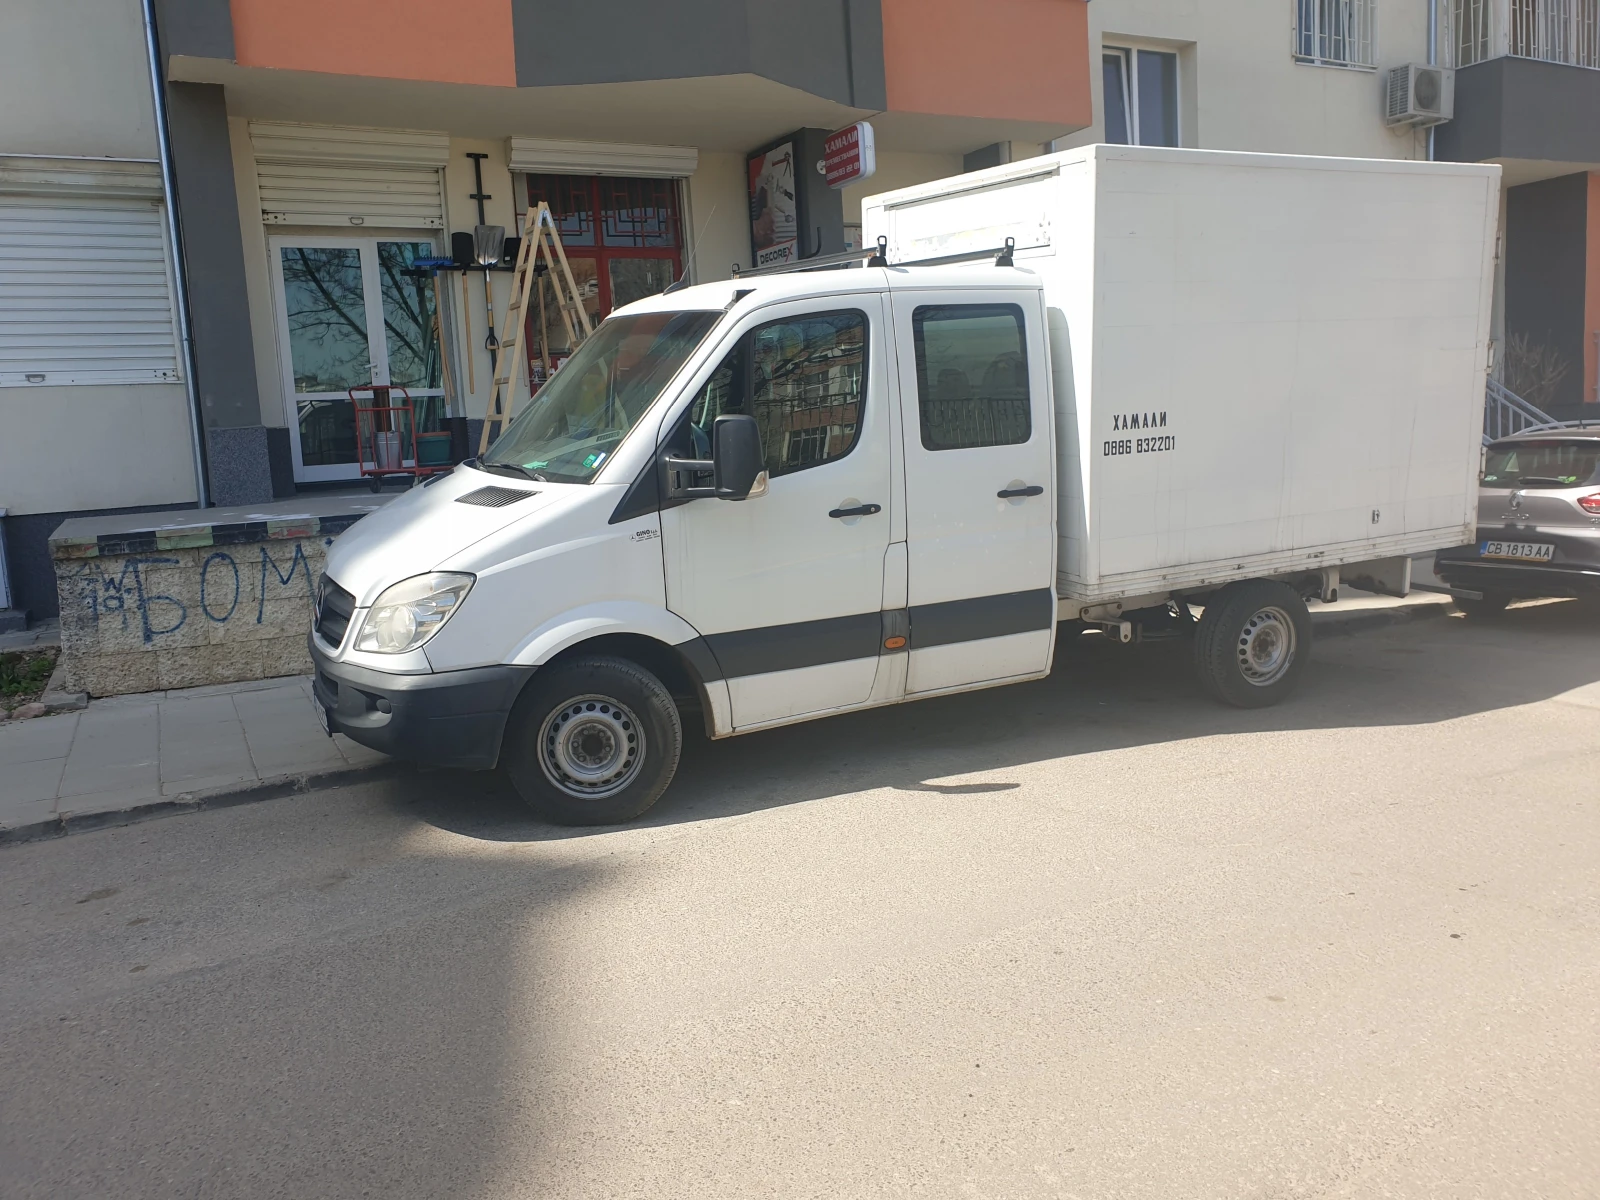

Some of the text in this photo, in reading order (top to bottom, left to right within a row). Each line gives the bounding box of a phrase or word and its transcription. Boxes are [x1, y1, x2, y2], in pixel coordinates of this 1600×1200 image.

[824, 130, 858, 154] ХАМАЛИ
[760, 243, 793, 264] DECOREX
[1112, 411, 1167, 431] ХАМАЛИ
[1103, 435, 1175, 456] 0886 832201
[1505, 543, 1533, 557] 1813
